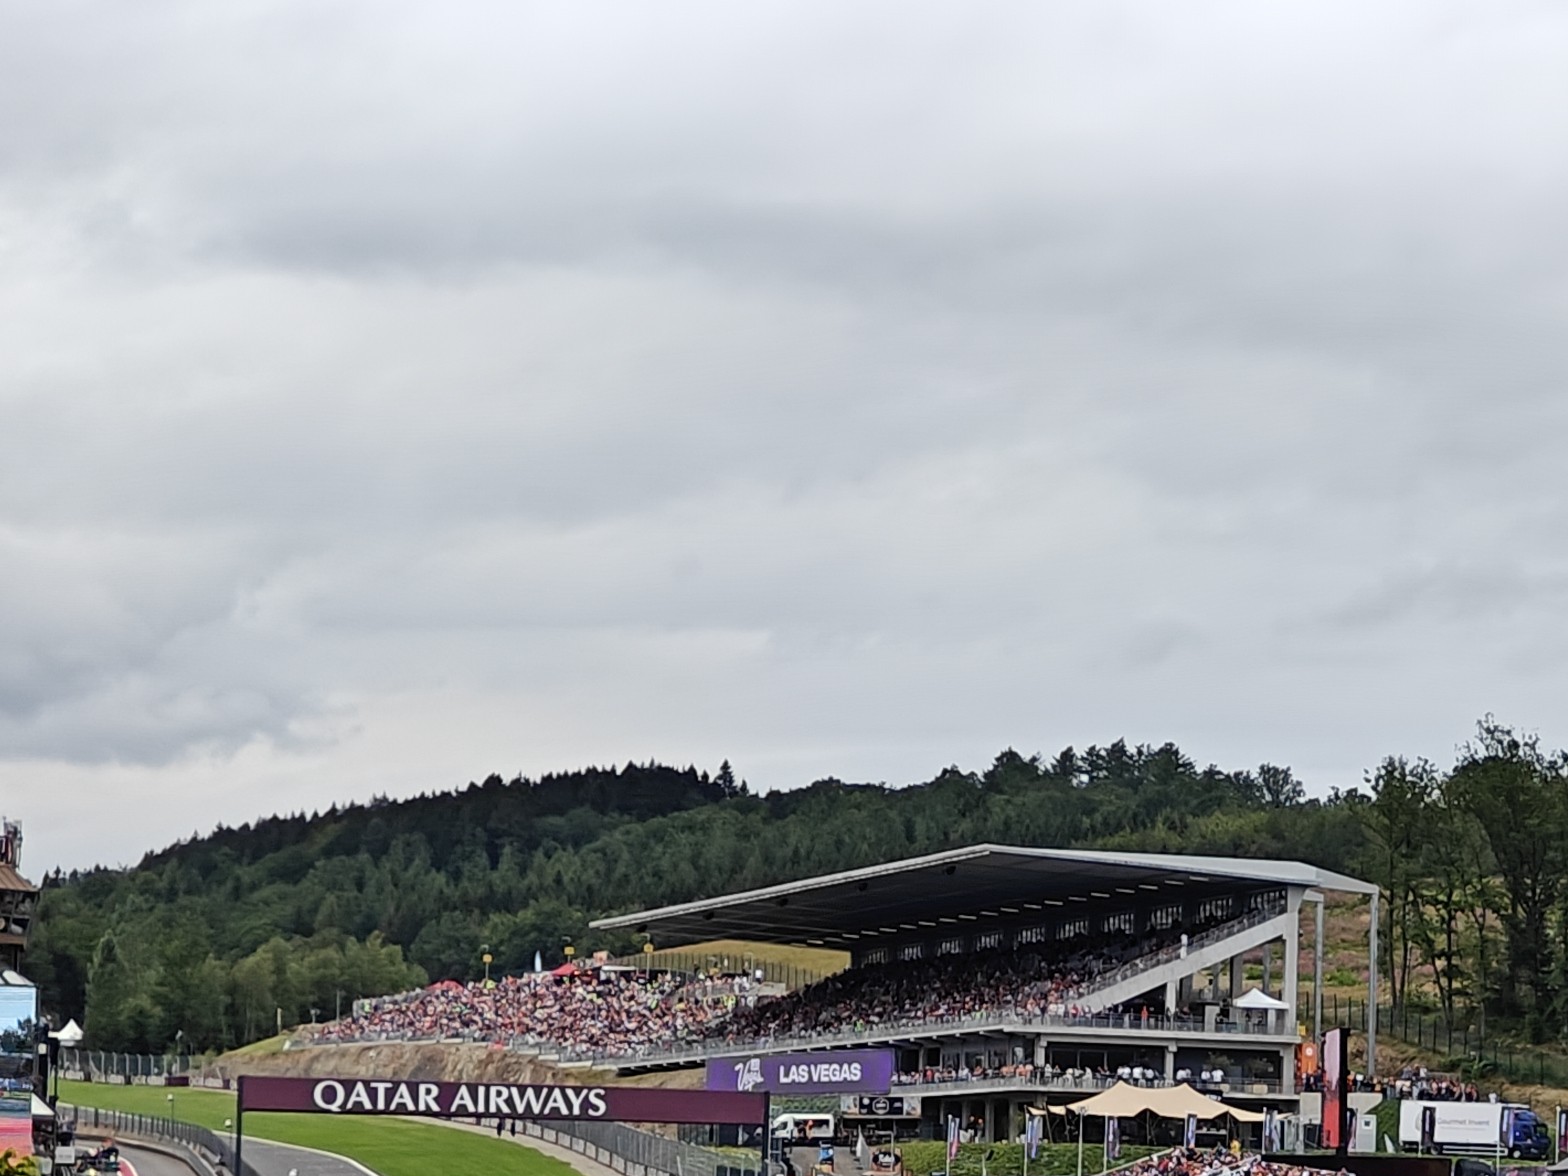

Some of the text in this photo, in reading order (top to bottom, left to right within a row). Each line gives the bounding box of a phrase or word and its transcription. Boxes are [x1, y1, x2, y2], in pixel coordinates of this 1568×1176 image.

[779, 1062, 862, 1083] LAS VEGAS
[313, 1079, 607, 1117] QATAR AIRWAYS
